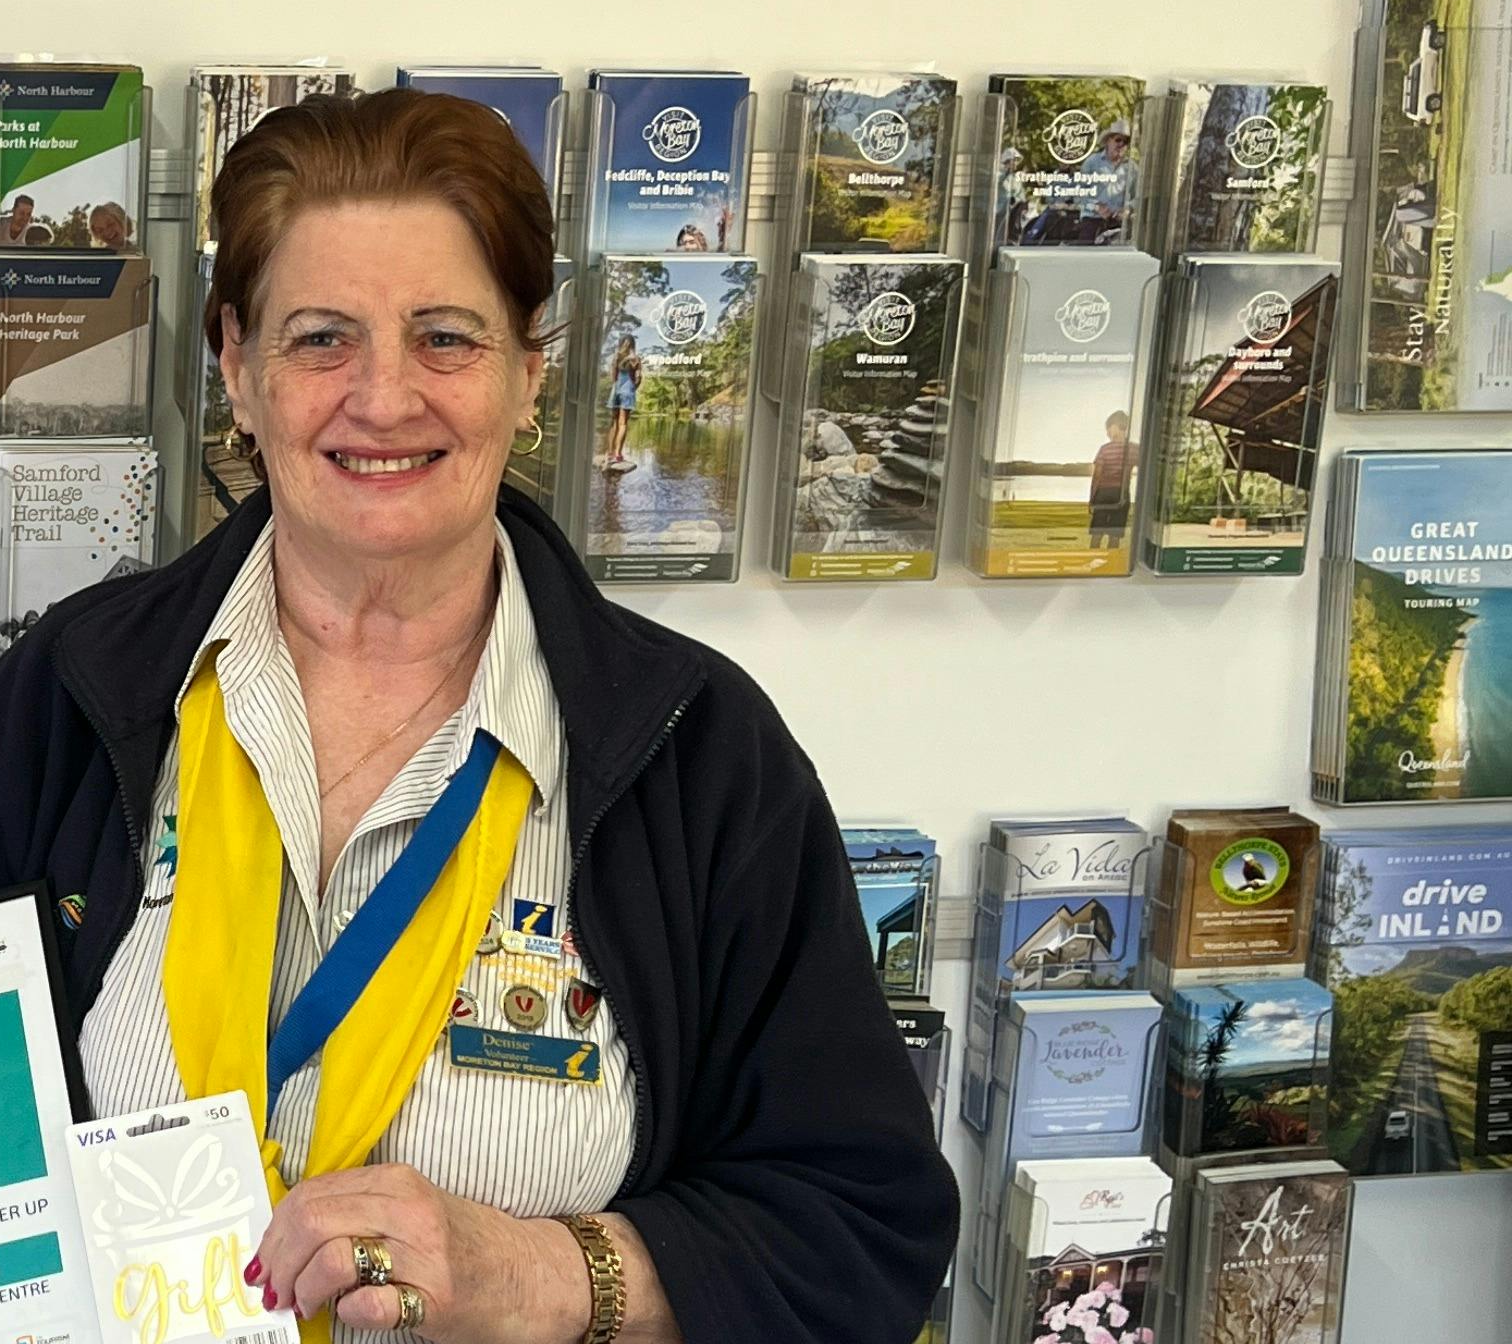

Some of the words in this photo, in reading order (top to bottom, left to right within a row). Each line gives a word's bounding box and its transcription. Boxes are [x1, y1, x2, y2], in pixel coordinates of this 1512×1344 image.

[17, 85, 49, 96] North
[52, 85, 94, 97] Harbour
[28, 121, 40, 132] at
[29, 136, 78, 149] Harbour
[658, 170, 710, 184] Deception
[714, 171, 730, 184] Bay
[848, 173, 904, 187] Bellthorpe
[1227, 177, 1269, 188] Samford
[640, 185, 662, 196] and
[665, 184, 693, 196] Bribie
[24, 273, 55, 284] North
[58, 273, 101, 285] Harbour
[1404, 306, 1424, 363] Stay
[856, 354, 907, 364] Wamuran
[12, 464, 101, 482] Samford
[12, 485, 82, 505] Village
[12, 505, 98, 525] Heritage
[11, 525, 62, 542] Trail
[1410, 522, 1479, 538] GREAT
[1405, 568, 1481, 585] DRIVES
[1016, 843, 1061, 880] La
[1071, 839, 1132, 881] Vida
[1402, 878, 1487, 905] drive
[482, 1034, 531, 1051] Denise
[457, 1055, 501, 1069] MORETON
[504, 1060, 521, 1070] BAY
[523, 1062, 558, 1074] REGION
[77, 1128, 117, 1147] VISA
[25, 1198, 49, 1215] UP
[1238, 1185, 1314, 1256] Art
